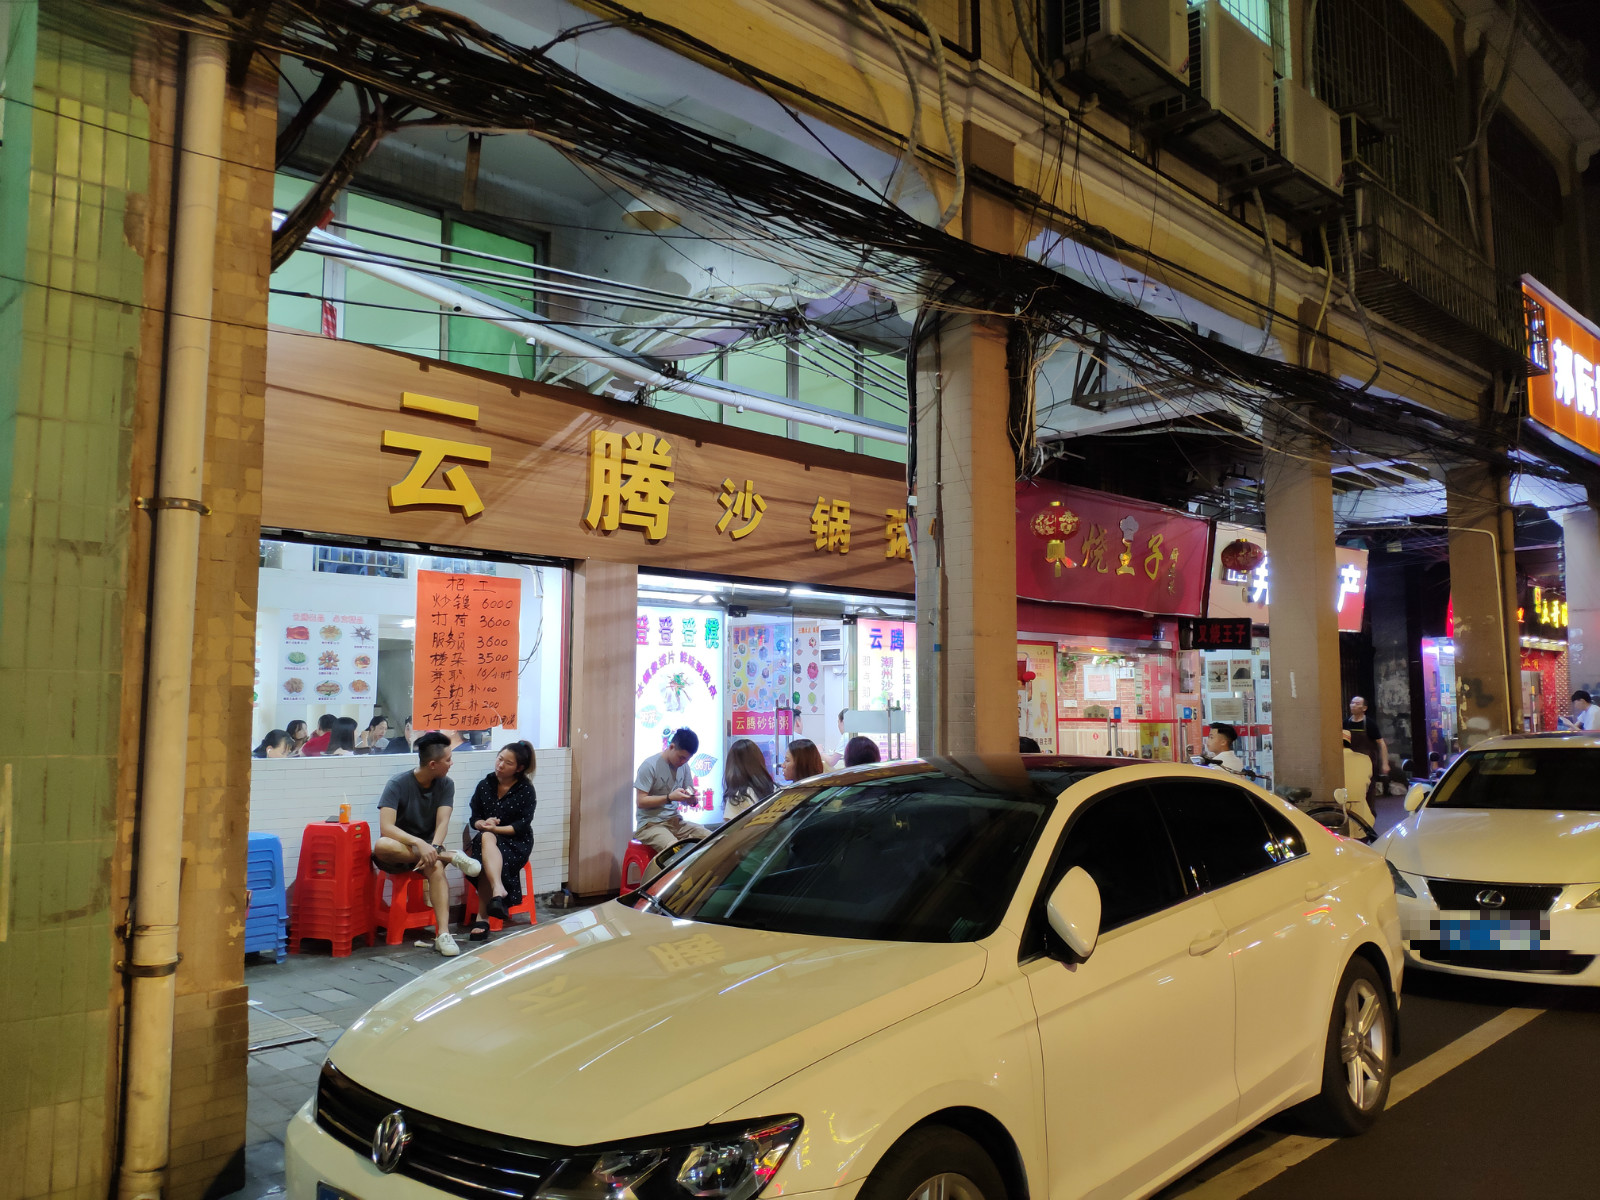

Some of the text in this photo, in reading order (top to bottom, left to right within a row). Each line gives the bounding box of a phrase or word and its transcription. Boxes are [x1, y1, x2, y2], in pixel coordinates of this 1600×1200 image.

[481, 597, 514, 610] 6000
[431, 611, 511, 629] 打荷 3600
[431, 626, 509, 652] 服务员 3600
[869, 628, 905, 652] 云腾
[476, 652, 509, 665] 3500
